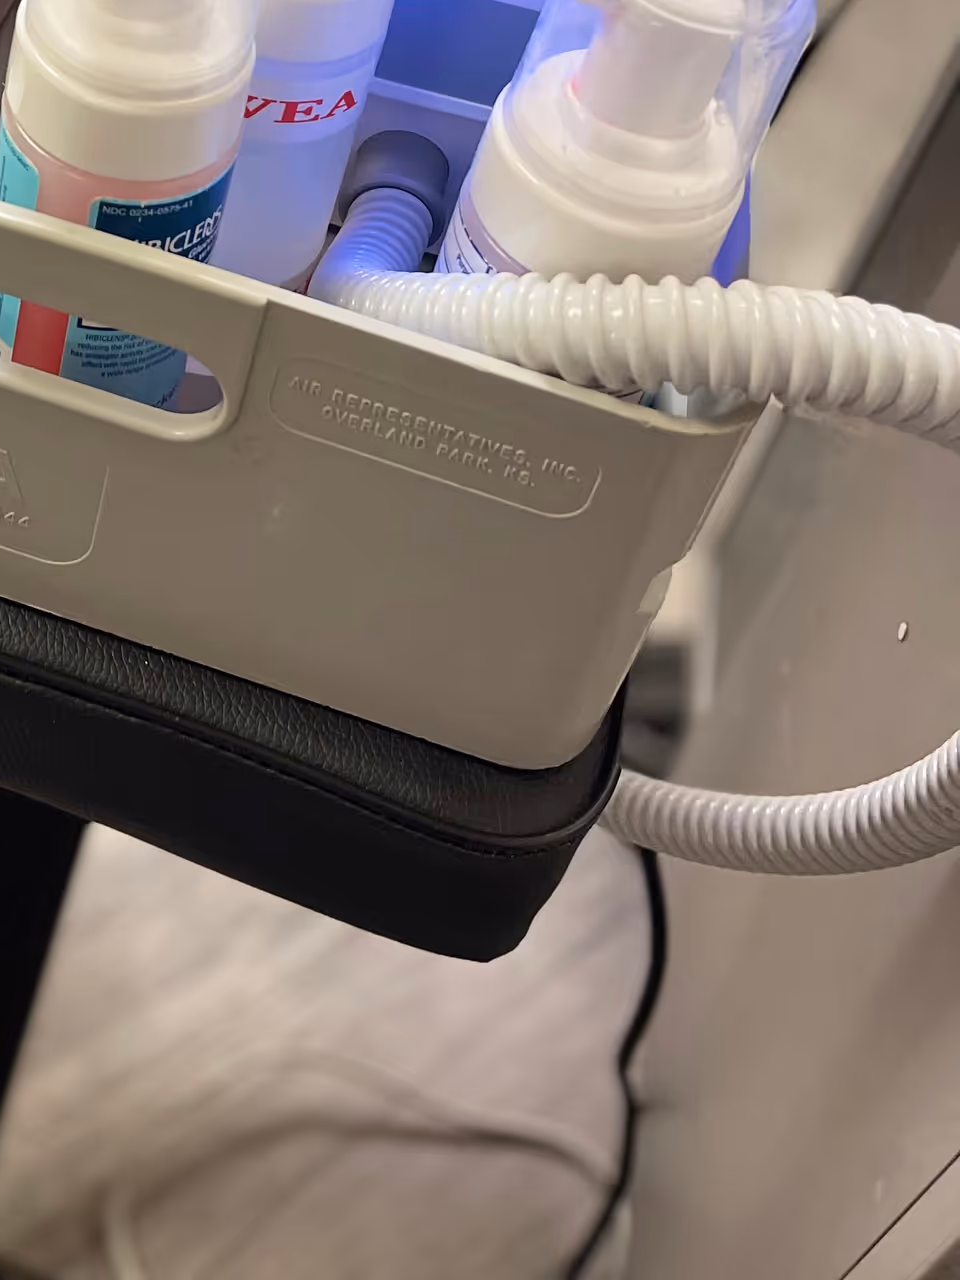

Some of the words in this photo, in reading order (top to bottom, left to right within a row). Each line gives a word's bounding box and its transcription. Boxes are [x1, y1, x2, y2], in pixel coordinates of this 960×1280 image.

[102, 205, 126, 216] NDC
[111, 343, 122, 351] the
[289, 376, 322, 397] AIR
[332, 389, 532, 468] REPRESENTATIVES,
[541, 458, 581, 483] INC.
[321, 405, 427, 450] OVERLAND
